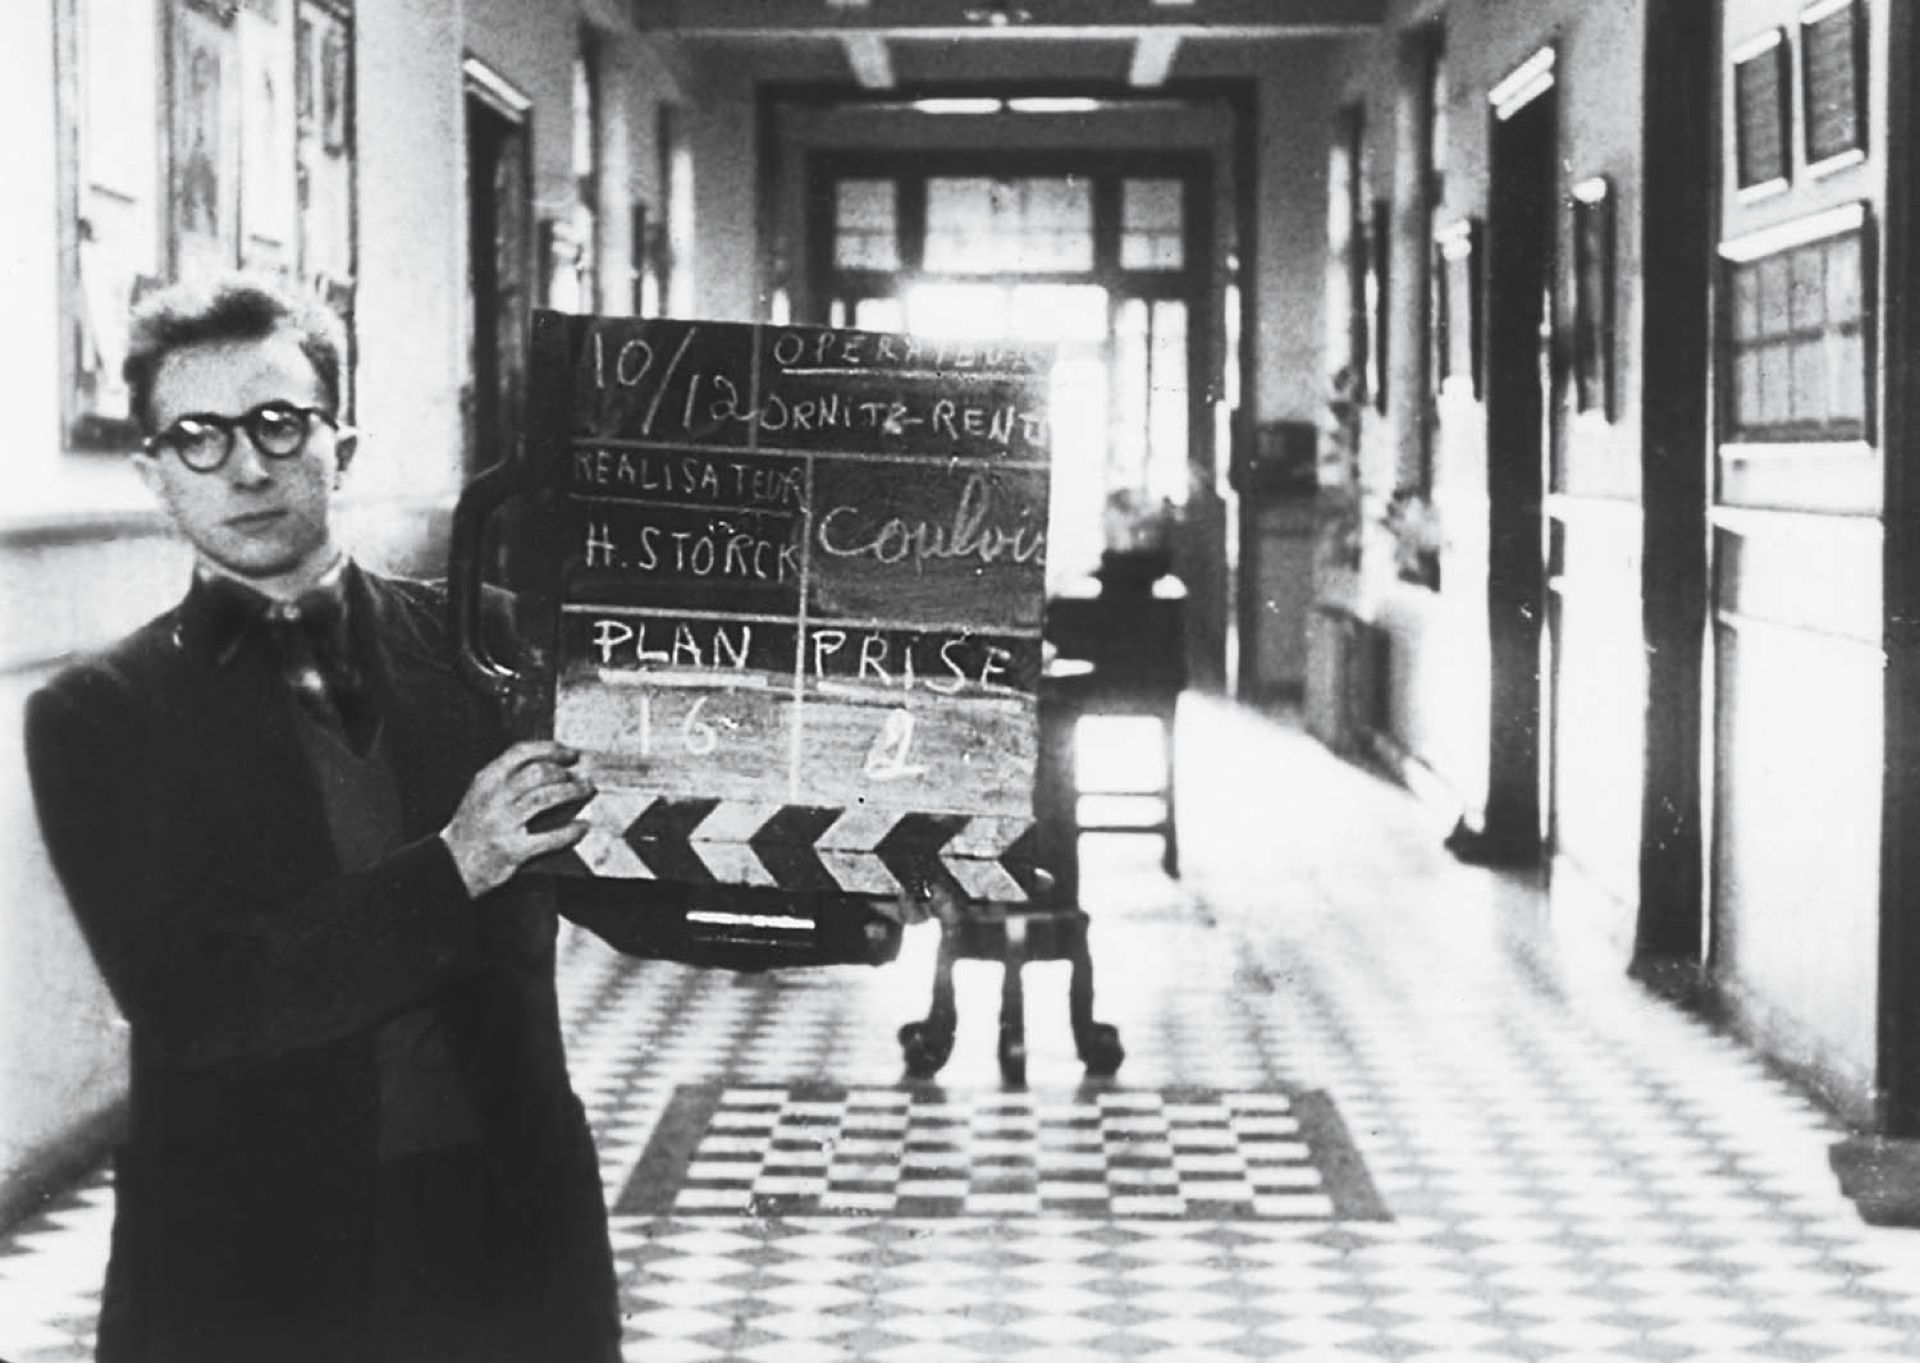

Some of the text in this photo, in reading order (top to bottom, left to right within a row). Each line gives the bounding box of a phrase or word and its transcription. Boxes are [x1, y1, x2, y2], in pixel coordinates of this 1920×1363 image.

[594, 327, 754, 434] 10/12
[575, 451, 804, 504] REALISATEUR
[592, 620, 751, 669] PLAN
[811, 629, 1012, 694] PRISE
[638, 695, 717, 756] 16
[863, 706, 928, 781] 2
